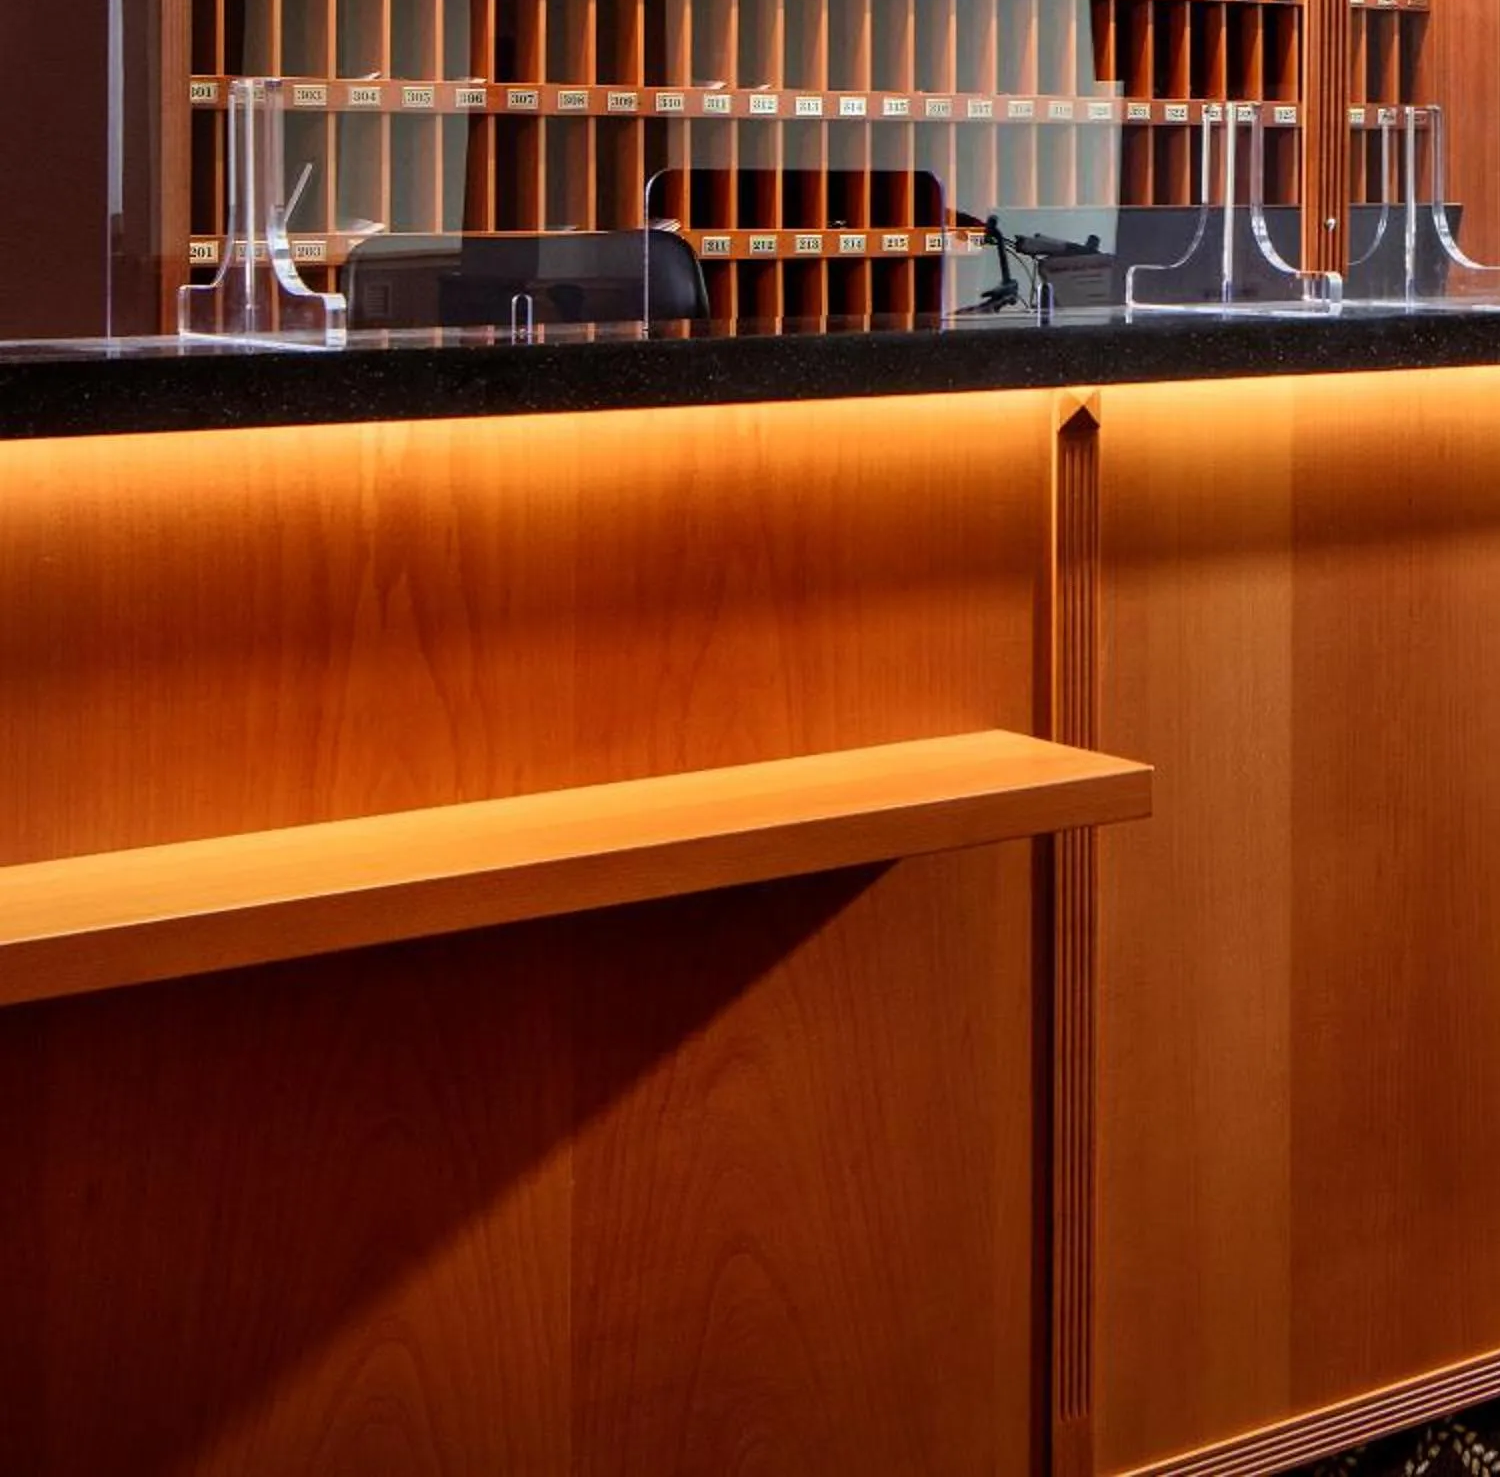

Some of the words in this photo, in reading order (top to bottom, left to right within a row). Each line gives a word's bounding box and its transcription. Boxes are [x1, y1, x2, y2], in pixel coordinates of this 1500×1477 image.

[352, 90, 377, 102] 304
[406, 92, 431, 104] 305
[460, 93, 484, 104] 306
[511, 94, 535, 105] 307
[611, 96, 634, 107] 309
[752, 99, 775, 110] 312
[707, 240, 727, 252] 211
[753, 240, 774, 250] 212
[799, 239, 819, 250] 213
[887, 238, 906, 249] 215
[190, 246, 212, 258] 201
[239, 247, 263, 258] 22
